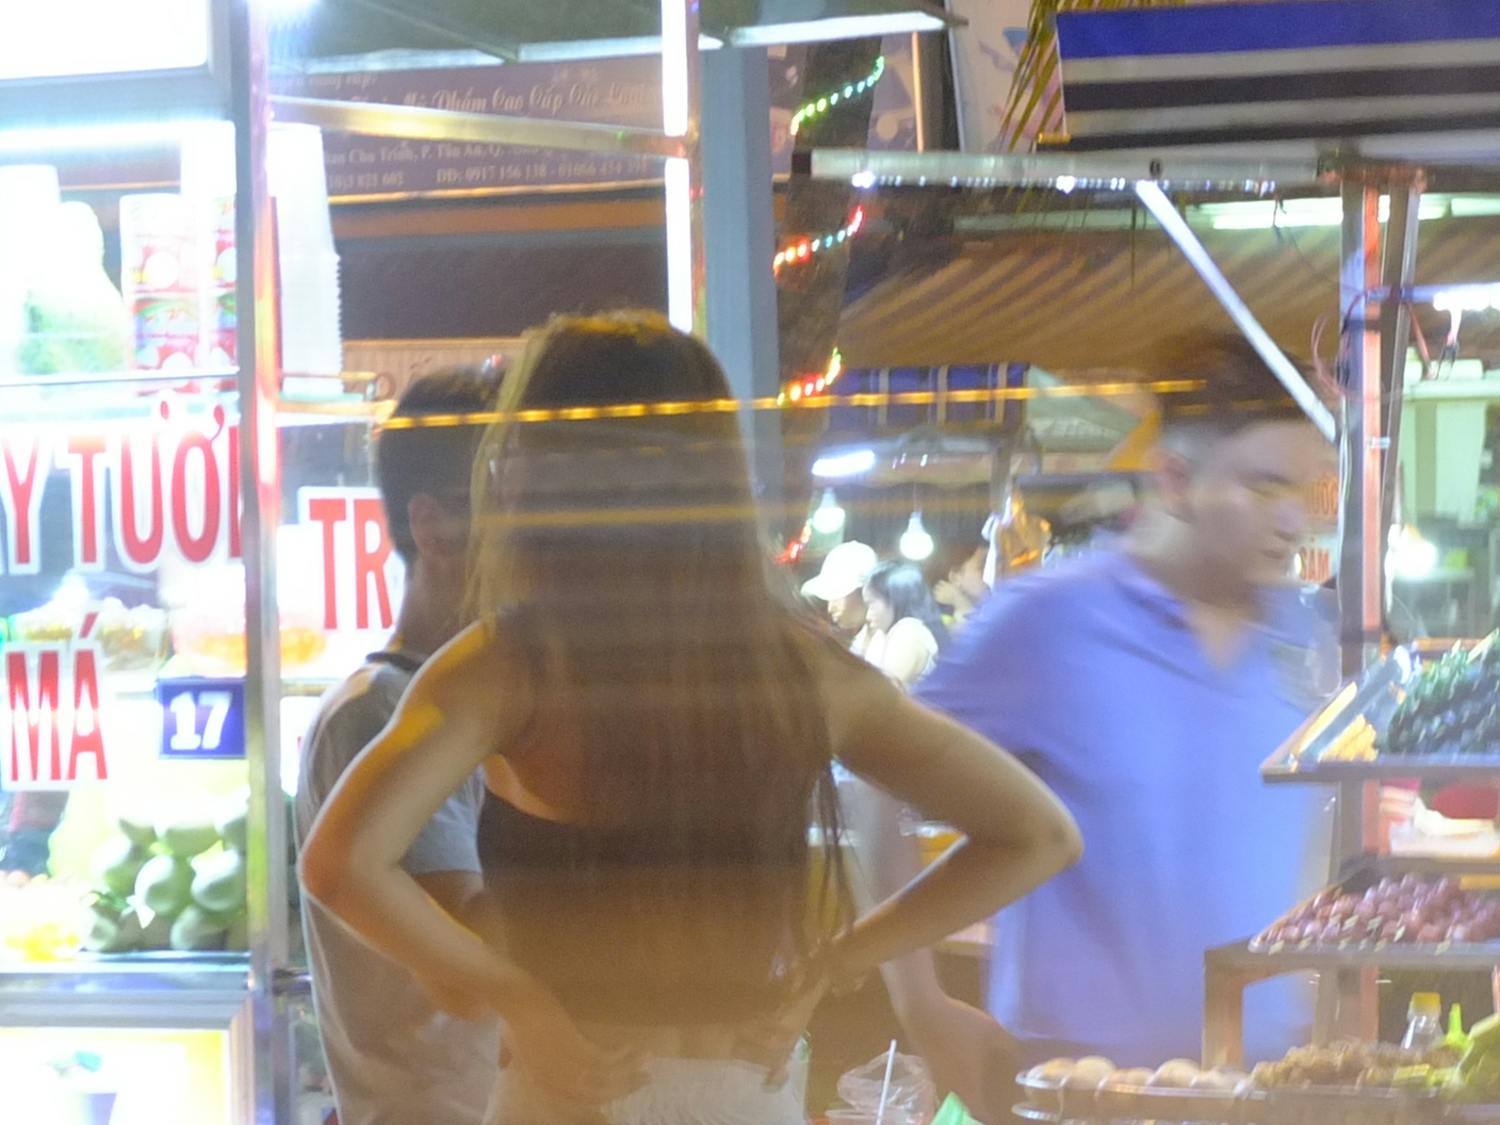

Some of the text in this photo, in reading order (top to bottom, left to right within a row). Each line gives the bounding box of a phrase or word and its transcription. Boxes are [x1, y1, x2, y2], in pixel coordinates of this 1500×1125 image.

[308, 497, 394, 631] TR
[6, 611, 108, 782] MÁ
[169, 692, 233, 751] 17
